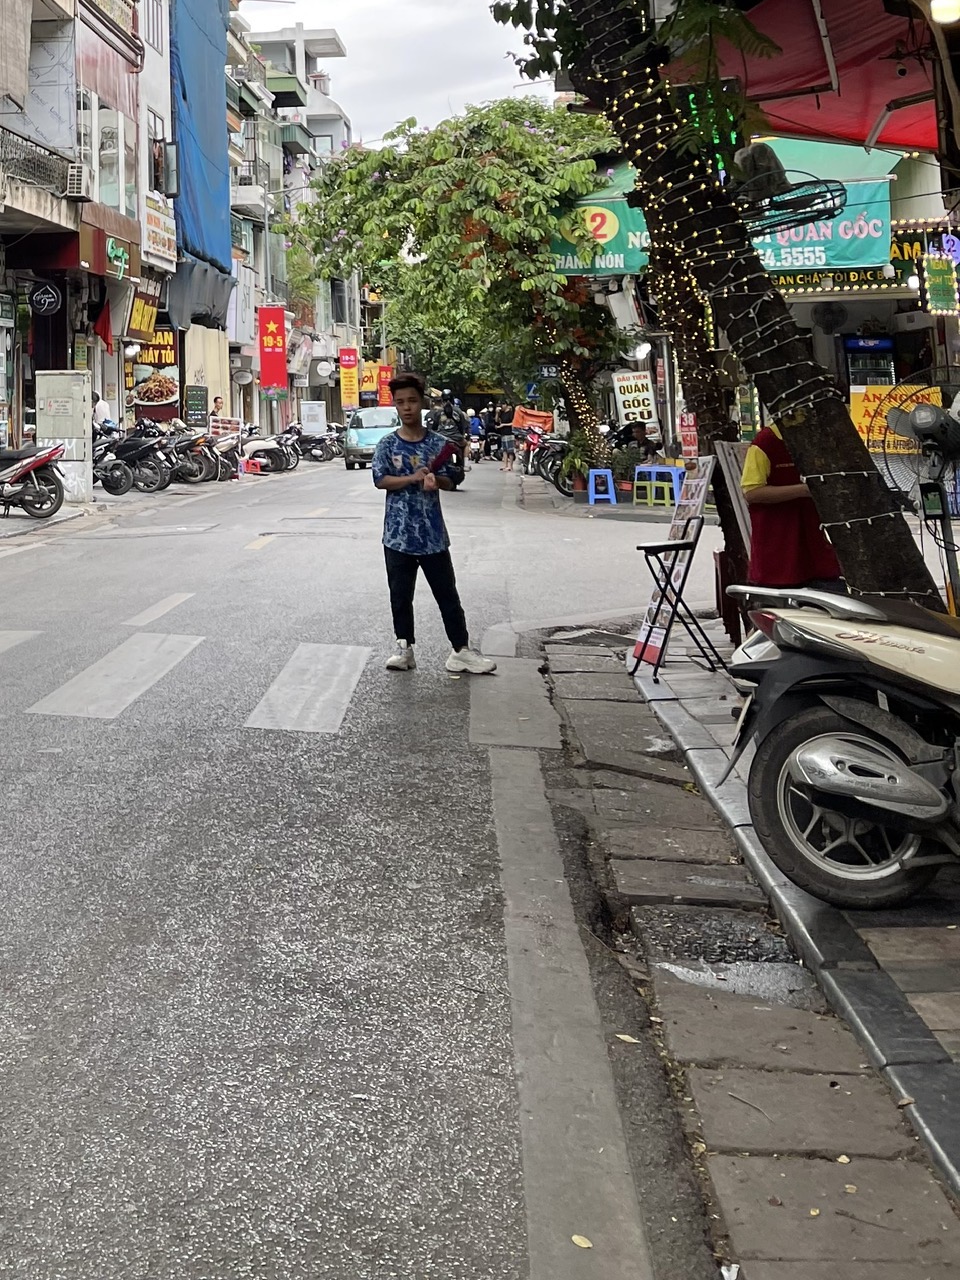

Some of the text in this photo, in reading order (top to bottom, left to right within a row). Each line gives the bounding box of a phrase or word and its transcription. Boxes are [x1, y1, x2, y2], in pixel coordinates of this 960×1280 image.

[839, 211, 884, 240] GỐC
[595, 251, 625, 269] NÓN
[262, 336, 283, 347] 19-5
[619, 381, 650, 395] QUÁN
[623, 394, 651, 409] GỐC
[682, 413, 695, 426] 38
